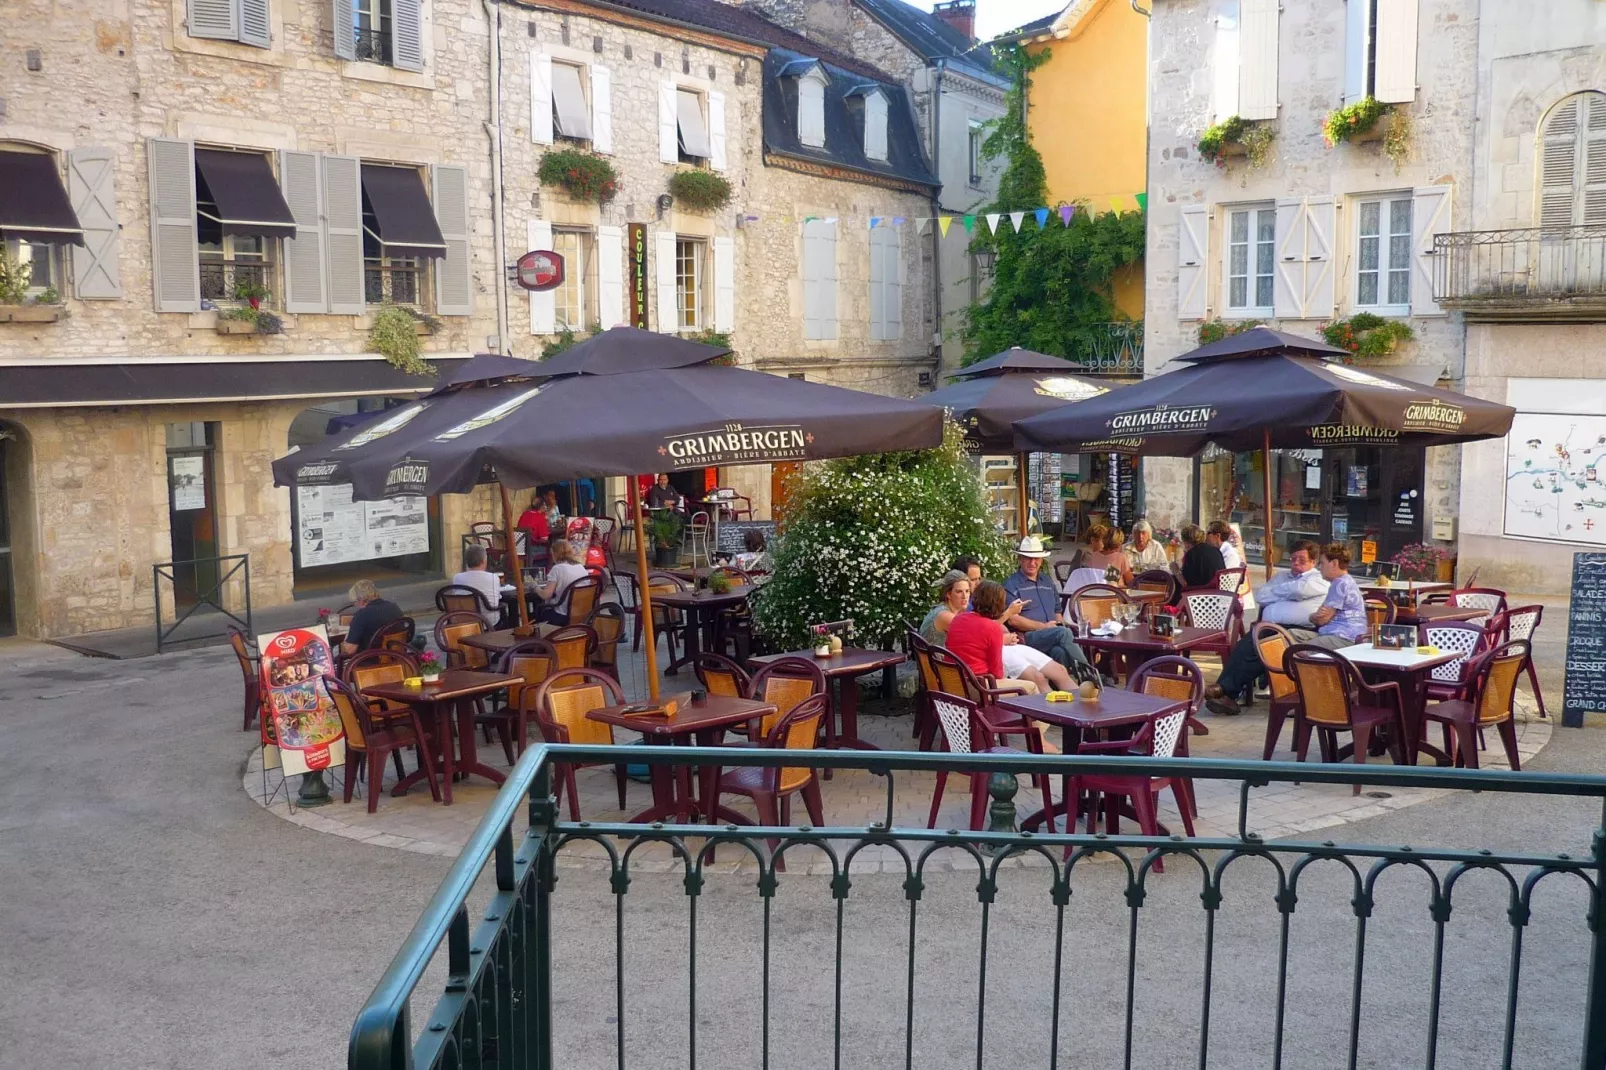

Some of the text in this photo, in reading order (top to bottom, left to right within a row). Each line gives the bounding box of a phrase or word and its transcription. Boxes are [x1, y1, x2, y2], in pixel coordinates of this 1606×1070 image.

[636, 228, 644, 315] COULEUR
[1112, 408, 1211, 429] GRIMBERGEN
[1406, 405, 1464, 424] GRIMBERGEN
[725, 423, 743, 432] 1128
[668, 429, 805, 458] GRIMBERGEN
[674, 449, 806, 466] ABDIJBIER BIÈRE D'ABBAYE
[1569, 636, 1604, 647] CROQUE
[1566, 699, 1595, 709] GRAND
